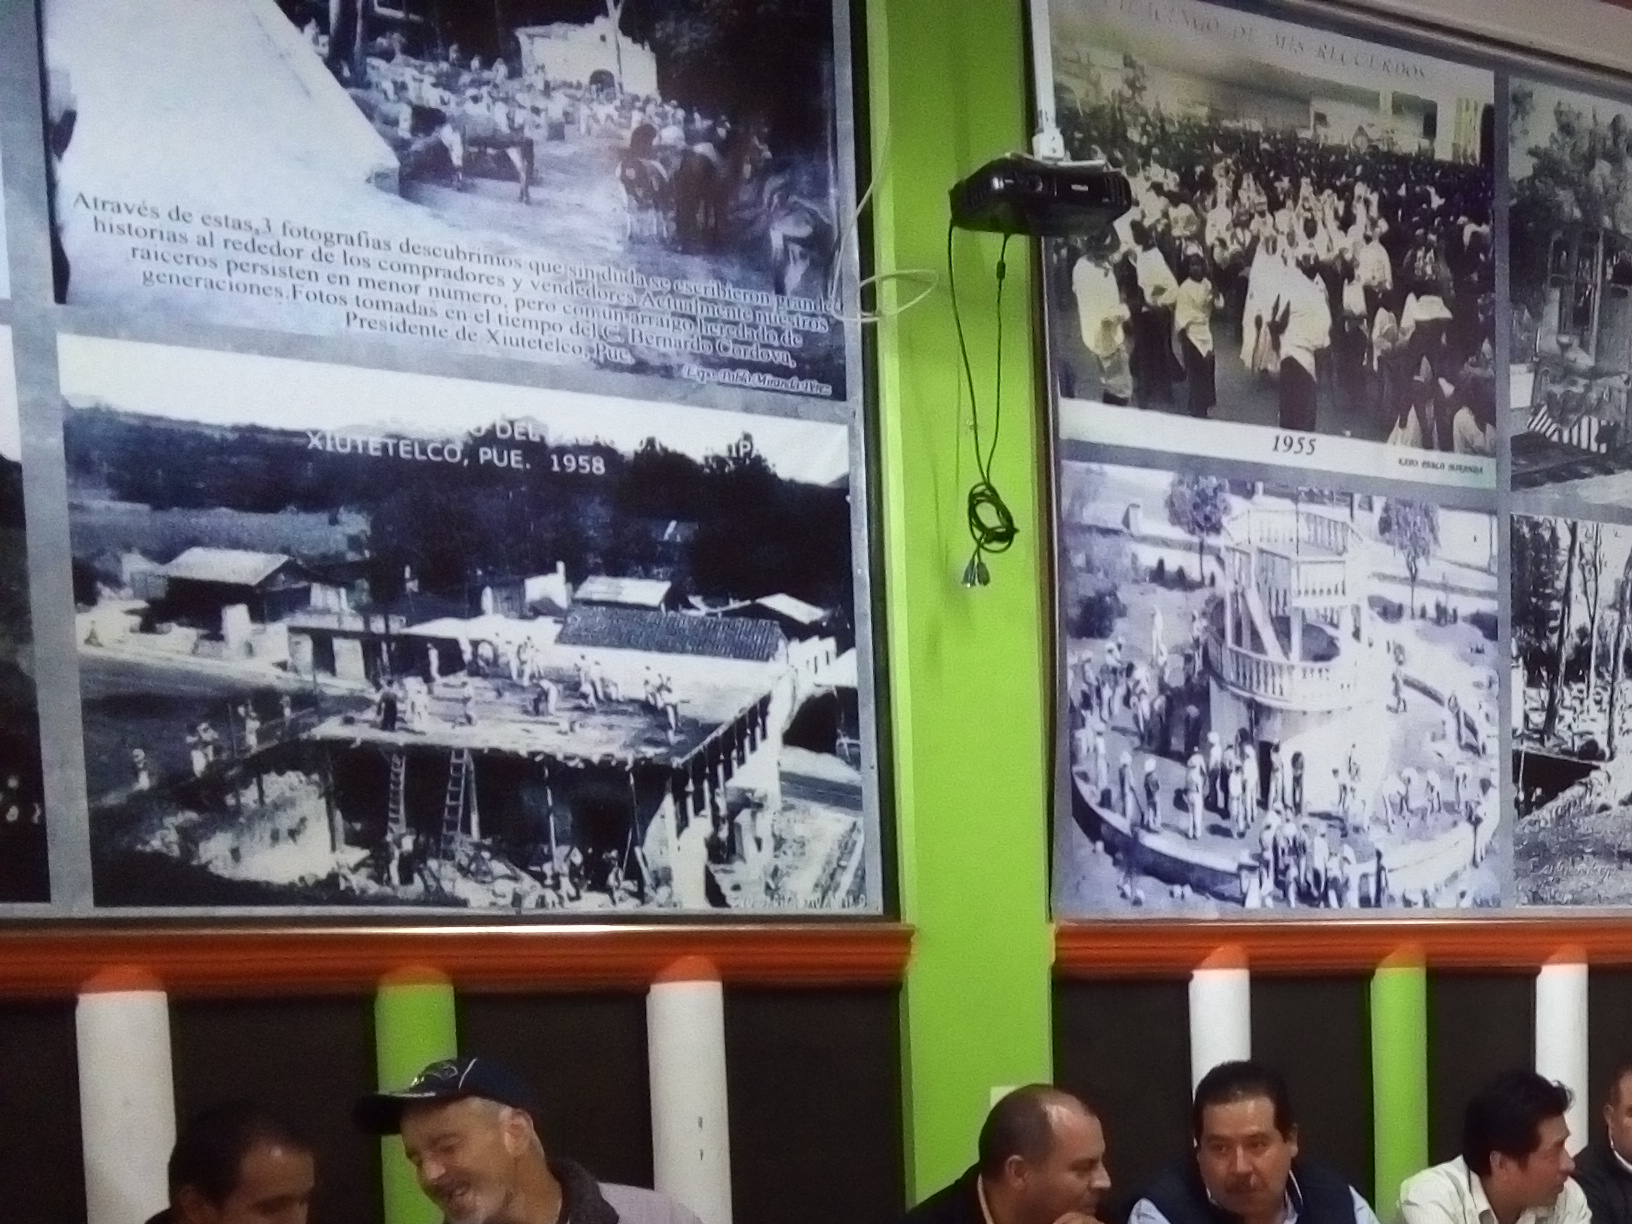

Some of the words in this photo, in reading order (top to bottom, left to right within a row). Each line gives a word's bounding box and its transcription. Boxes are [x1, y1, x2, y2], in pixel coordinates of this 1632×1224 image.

[73, 191, 160, 219] Através
[168, 204, 193, 223] de
[400, 237, 522, 268] descubrimos
[529, 259, 563, 276] que
[568, 261, 595, 280] sin
[602, 266, 647, 287] duda
[673, 278, 770, 304] escribieron
[93, 215, 188, 244] historias
[197, 231, 214, 248] al
[223, 237, 304, 260] rededor
[312, 246, 335, 264] de
[343, 250, 371, 269] los
[379, 259, 505, 287] compradores
[513, 277, 523, 293] y
[642, 291, 754, 321] Actualmente
[131, 246, 218, 269] raiceros
[226, 257, 319, 283] persisten
[327, 272, 350, 286] en
[358, 276, 420, 297] menor
[515, 296, 556, 313] pero
[562, 303, 596, 319] con
[602, 308, 625, 322] un
[630, 311, 694, 334] arraigo
[699, 318, 780, 344] heredado
[781, 329, 802, 347] de
[345, 310, 449, 339] Presidente
[456, 325, 478, 342] de
[355, 294, 438, 318] tomadas
[445, 307, 467, 322] en
[474, 308, 490, 325] el
[498, 311, 563, 336] tiempo
[570, 320, 597, 338] del
[630, 328, 713, 354] Bernardo
[306, 429, 469, 466] XIUTETELCO,
[479, 446, 531, 470] PUE.
[551, 453, 605, 476] 1958
[496, 419, 541, 442] DEL
[1272, 434, 1317, 456] 1955
